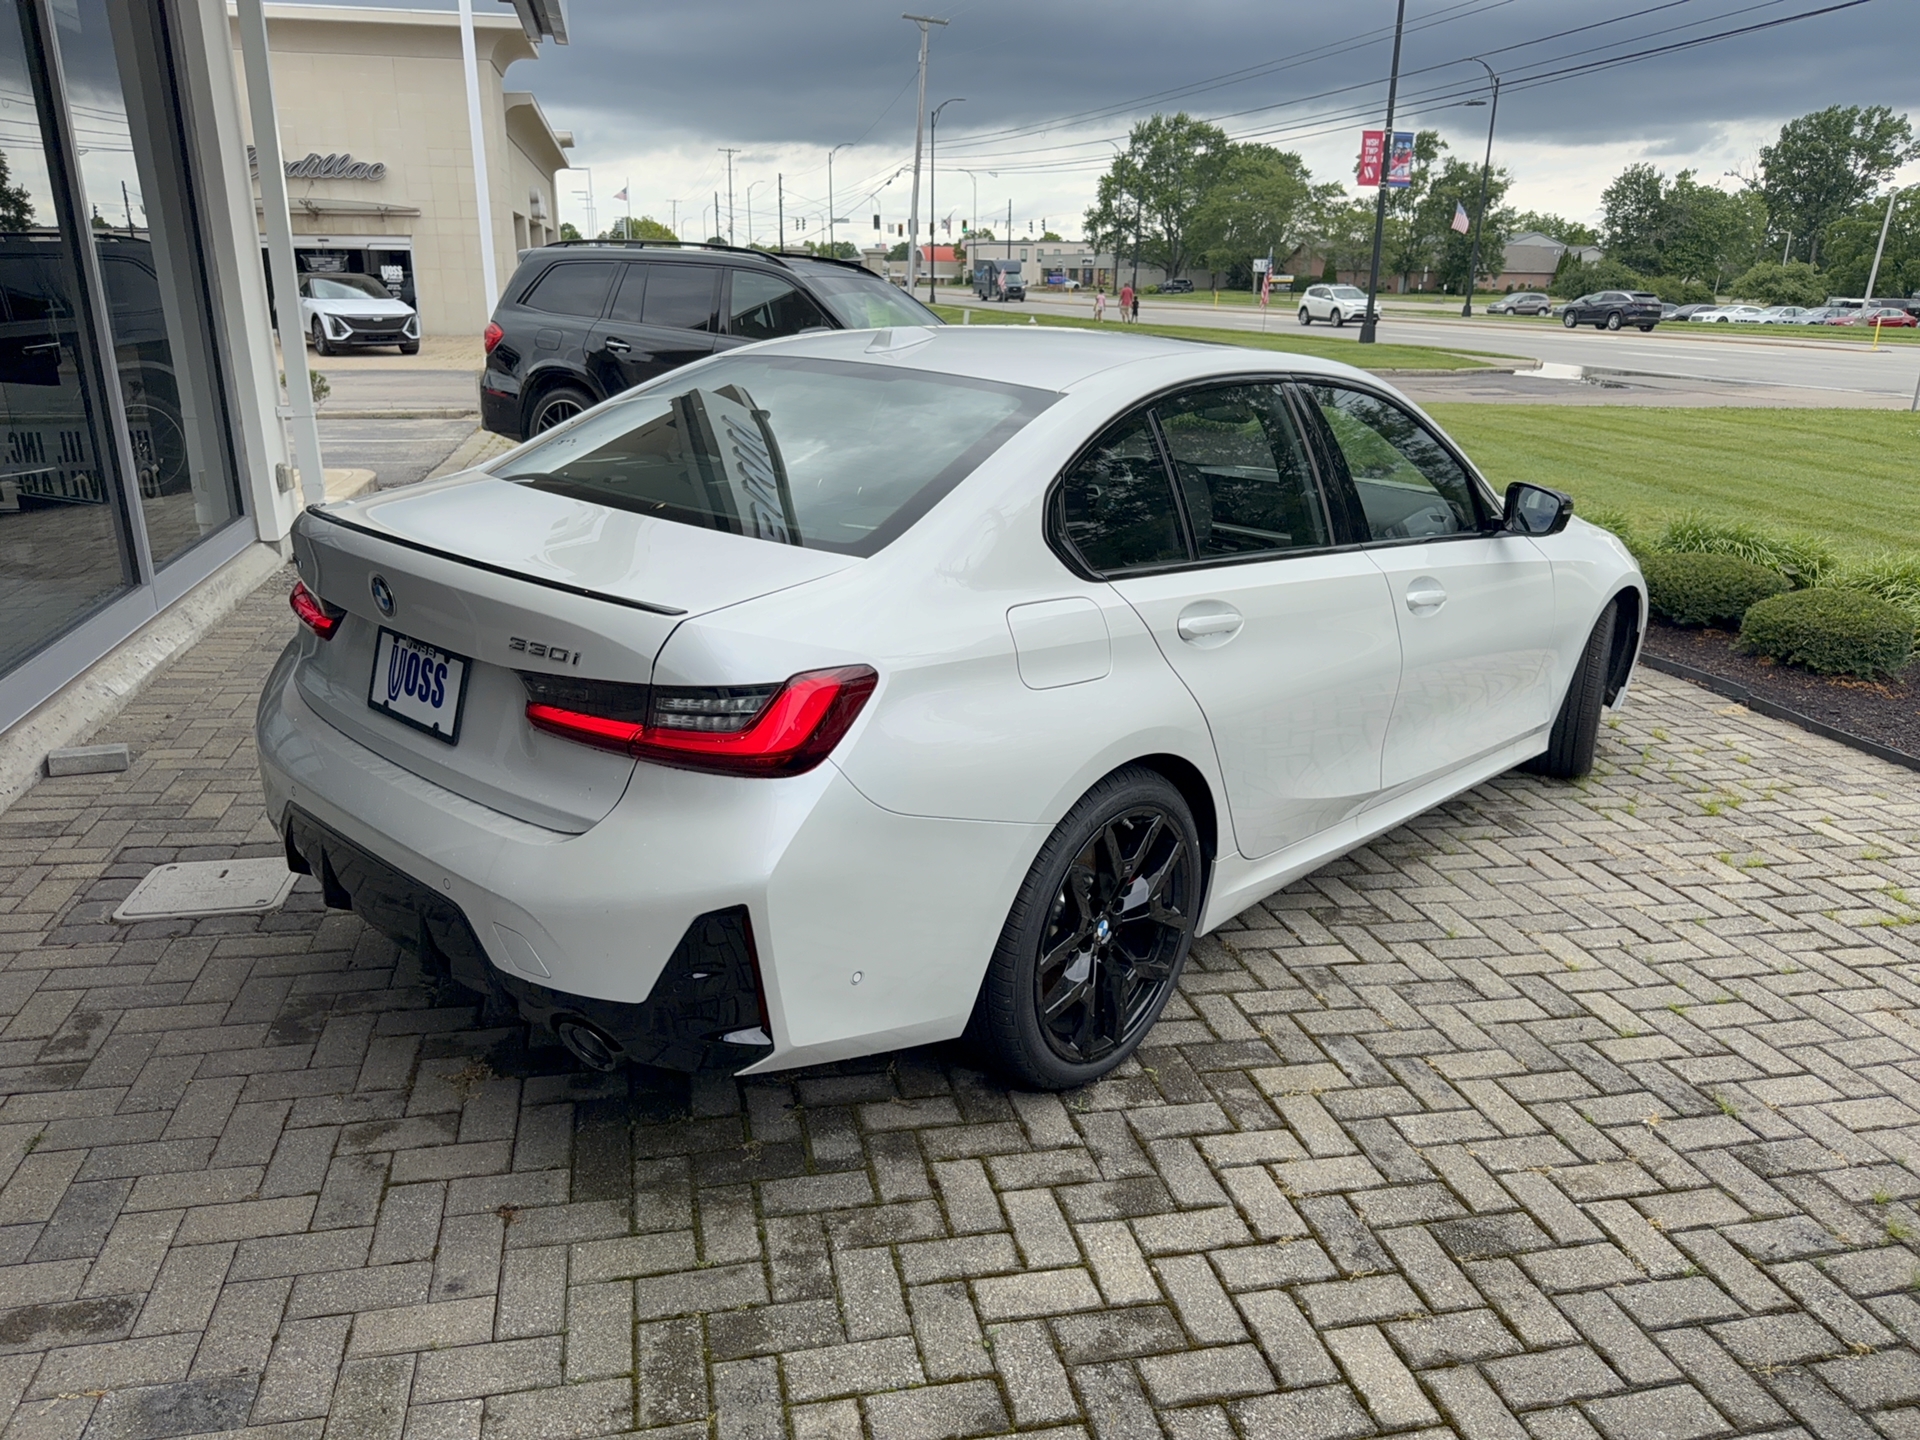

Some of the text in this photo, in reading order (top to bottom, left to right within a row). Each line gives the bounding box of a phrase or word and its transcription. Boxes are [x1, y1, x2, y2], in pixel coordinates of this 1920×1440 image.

[1365, 147, 1379, 155] TWP
[509, 636, 582, 667] 330i
[387, 643, 448, 709] VOSS
